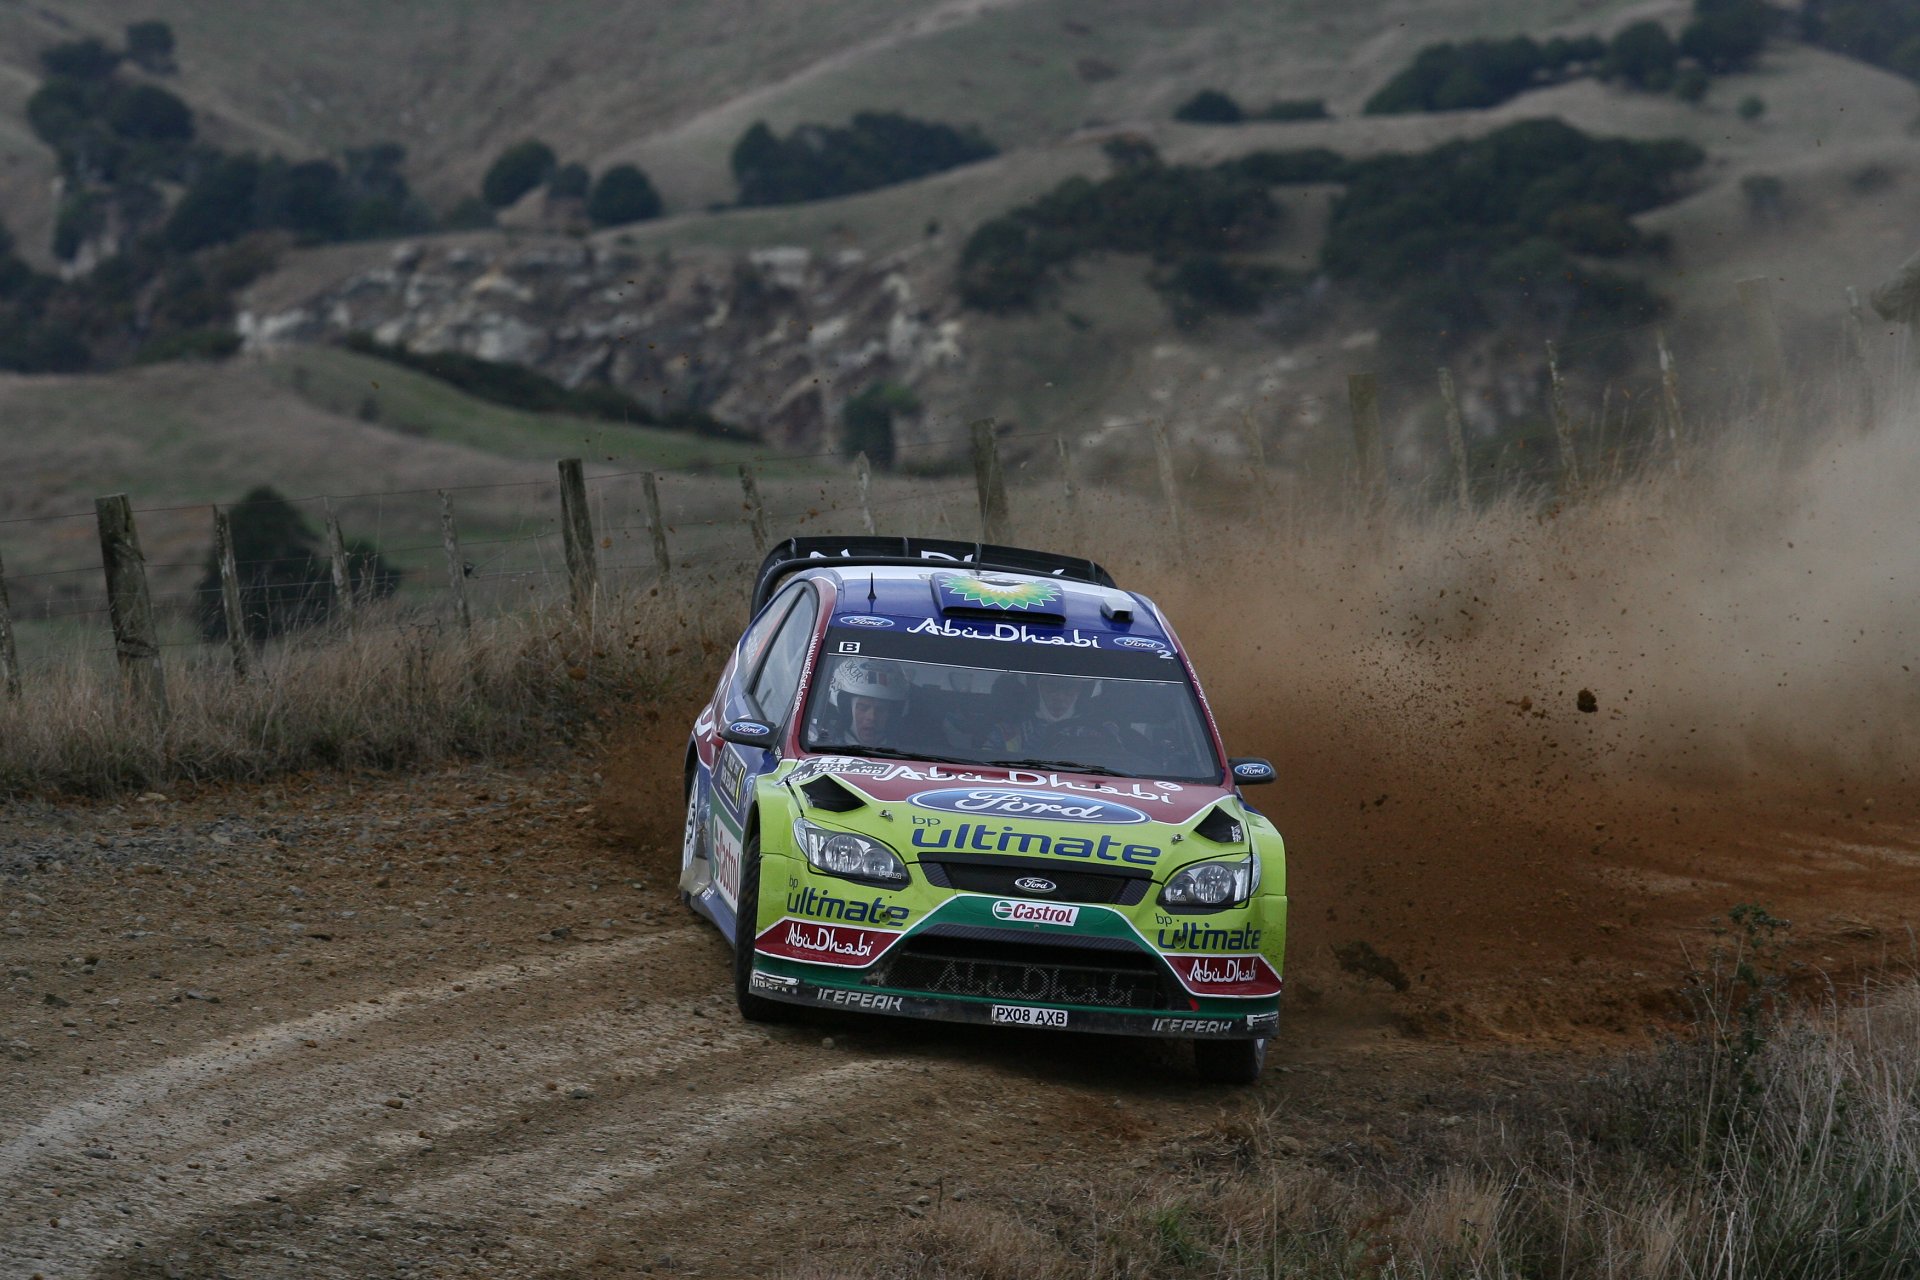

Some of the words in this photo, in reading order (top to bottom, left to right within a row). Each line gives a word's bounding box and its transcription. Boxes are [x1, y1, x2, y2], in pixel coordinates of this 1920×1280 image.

[843, 643, 858, 652] B
[1157, 650, 1174, 659] 2
[955, 790, 1104, 819] Ford
[912, 816, 941, 827] bp
[912, 824, 1161, 865] ultimate
[789, 874, 798, 890] bp
[787, 886, 909, 927] ultimate
[1013, 903, 1073, 923] Castrol
[1155, 913, 1173, 927] bp
[1157, 922, 1262, 950] ultimate
[996, 1007, 1030, 1022] PX08
[1035, 1010, 1065, 1025] AXB
